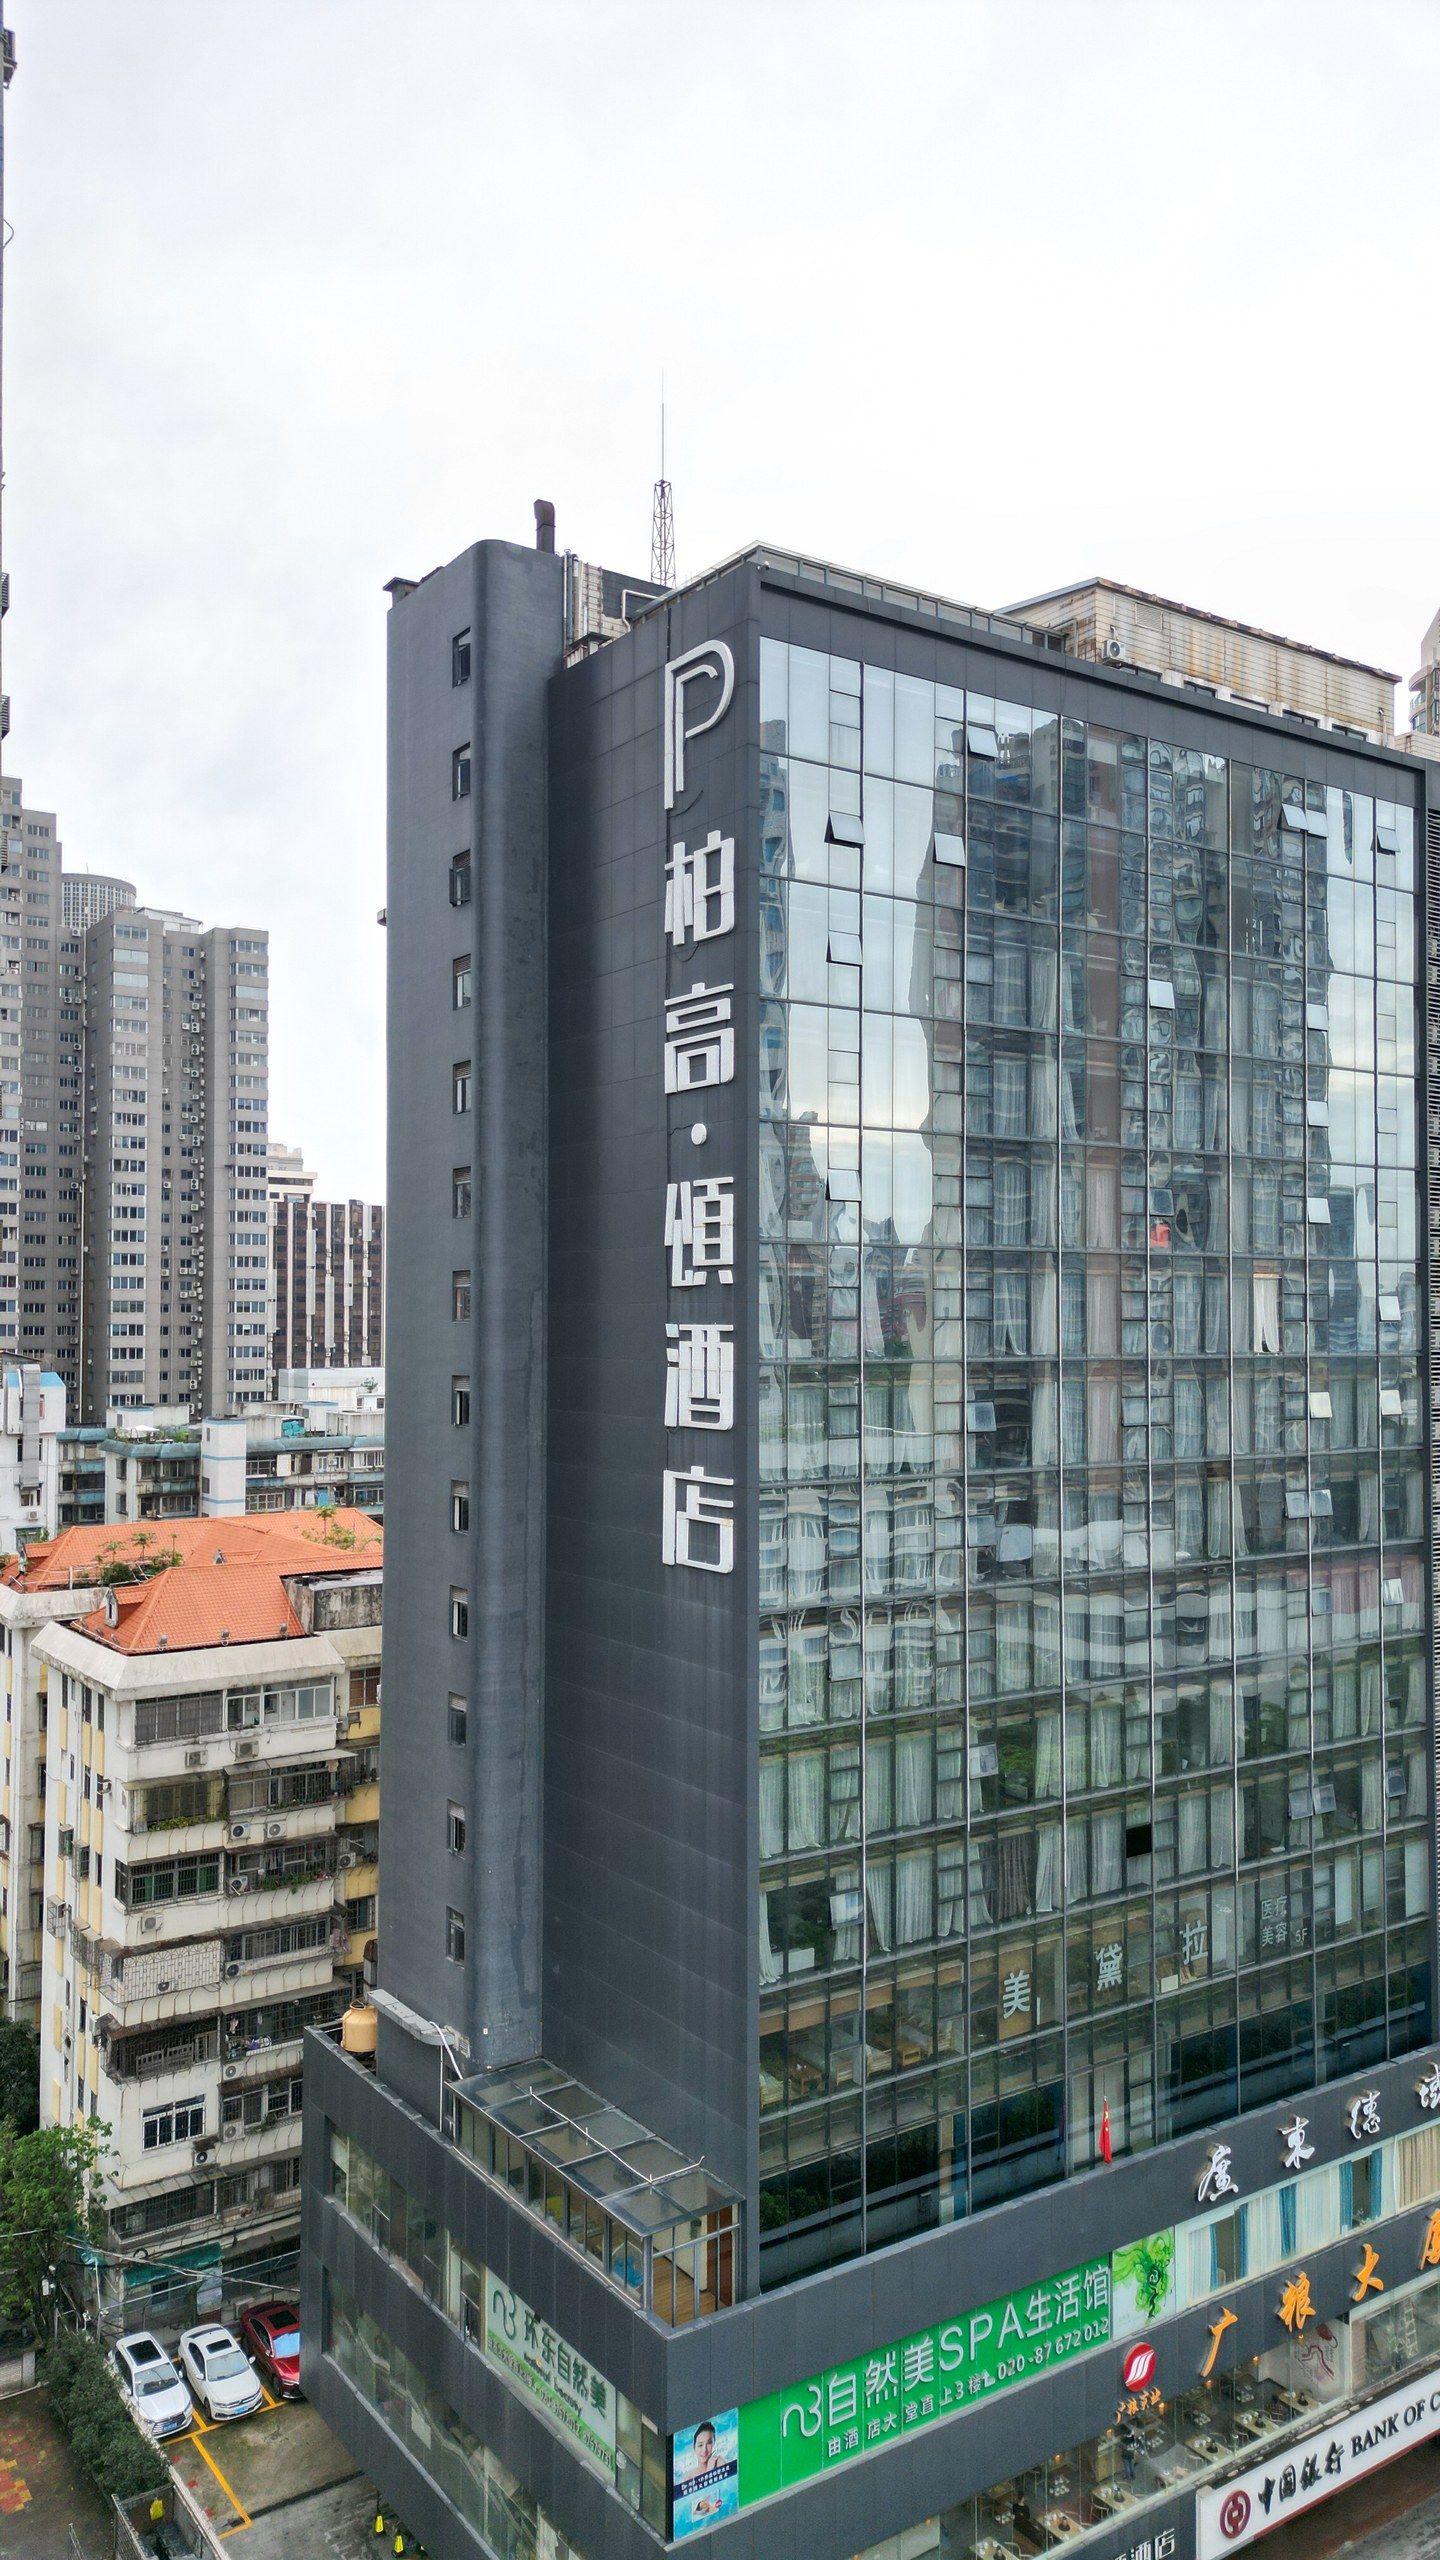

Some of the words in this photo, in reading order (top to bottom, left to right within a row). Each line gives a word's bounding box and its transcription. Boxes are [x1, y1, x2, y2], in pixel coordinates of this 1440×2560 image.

[1261, 1895, 1288, 1921] 医疗
[1261, 1922, 1289, 1948] 美容
[1003, 1919, 1209, 2020] 美黛拉
[827, 2264, 1110, 2427] 自然美SPA生活馆
[1350, 2412, 1400, 2458] BANK
[1403, 2398, 1426, 2427] OF
